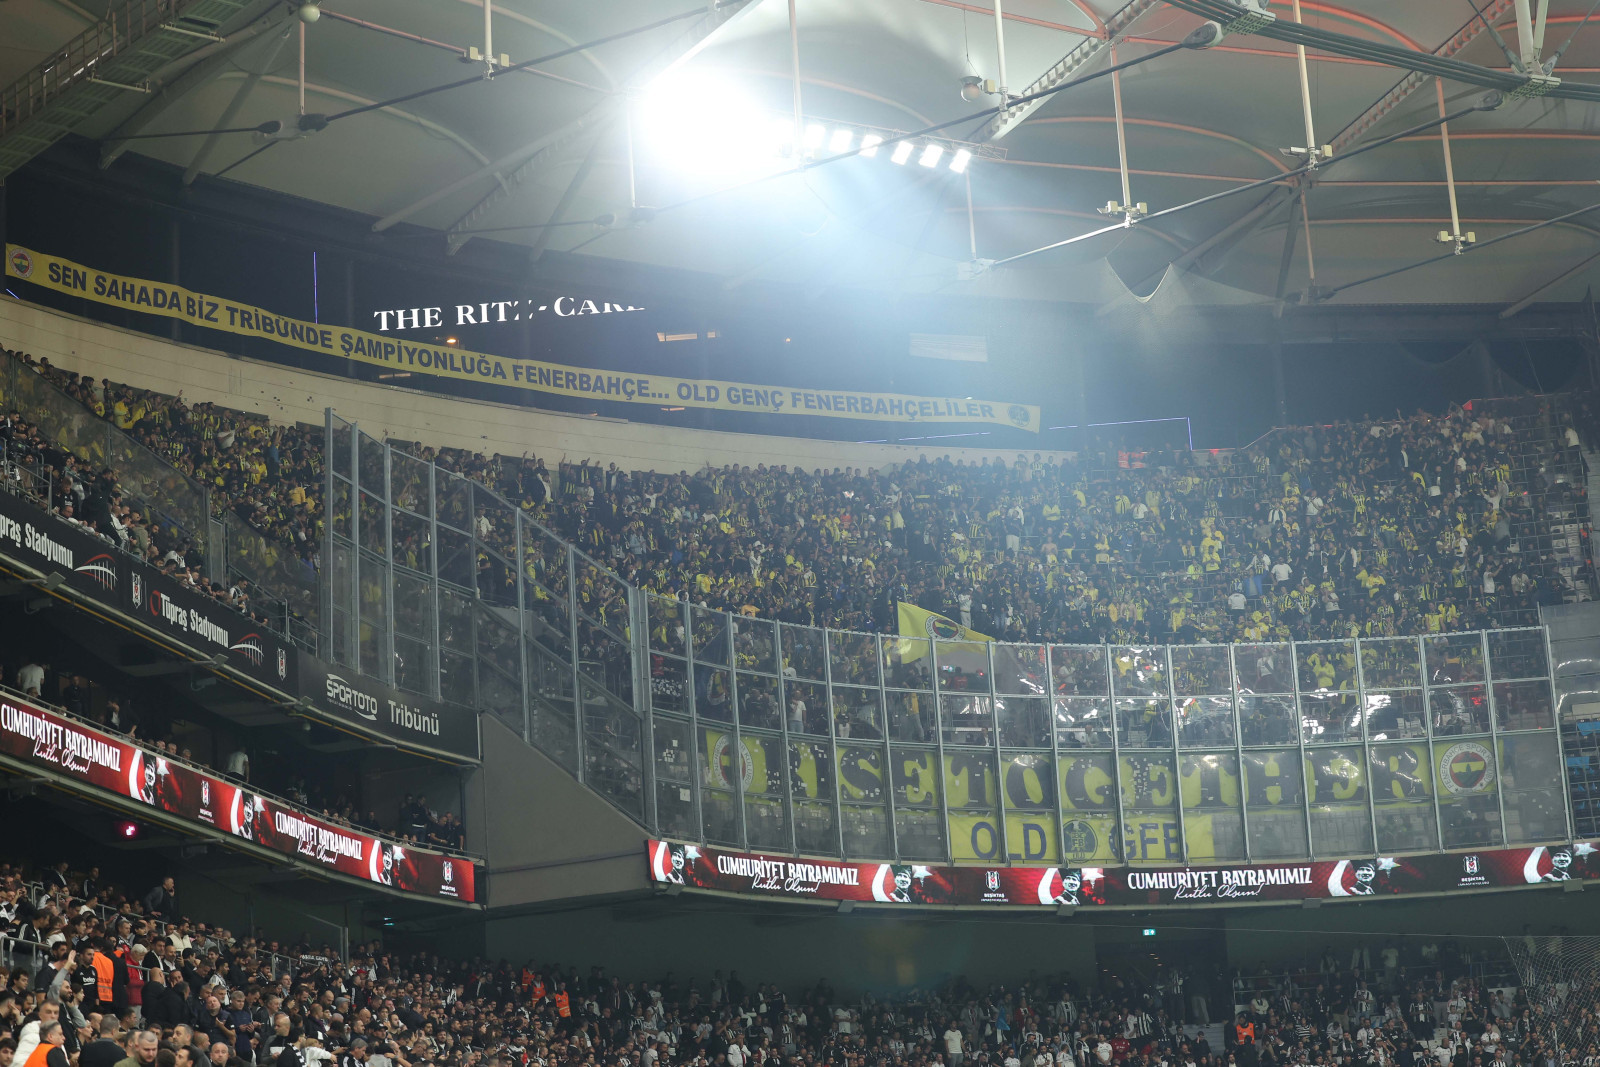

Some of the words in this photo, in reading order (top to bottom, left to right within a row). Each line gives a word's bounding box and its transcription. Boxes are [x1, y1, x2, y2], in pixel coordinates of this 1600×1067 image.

[373, 306, 443, 331] THE
[48, 262, 87, 291] SEN
[93, 274, 182, 313] SAHADA
[186, 296, 219, 323] BİZ
[225, 305, 333, 349] TRİBÜNDE
[340, 332, 507, 381] ŞAMPİYONLUĞA
[511, 363, 670, 401] FENERBAHÇE...
[676, 382, 720, 402] OLD
[726, 386, 785, 412] GENÇ
[790, 390, 996, 421] FENERBAHÇELİLER
[24, 522, 73, 570] Stadyumu
[160, 592, 188, 632] Tüpraş
[190, 608, 229, 649] Stadyumu
[326, 679, 378, 715] SPORTOTO
[387, 699, 440, 736] Tribünü
[0, 703, 64, 750] CUMHURİYET
[65, 727, 121, 772] BAYRAMIMIZ
[275, 810, 318, 845] CUMHURİYET
[318, 829, 363, 861] BAYRAMIMIZ
[1108, 822, 1190, 860] GFB
[717, 855, 785, 878] CUMHURİYET
[788, 862, 860, 886] BAYRAMIMIZ
[751, 874, 781, 890] Kutlu
[784, 878, 821, 894] Olsun!
[1127, 867, 1218, 890] CUMHURİYET
[1222, 867, 1313, 888] BAYRAMIMIZ
[1174, 884, 1212, 901] Kutlu
[1216, 883, 1264, 899] Olsun!
